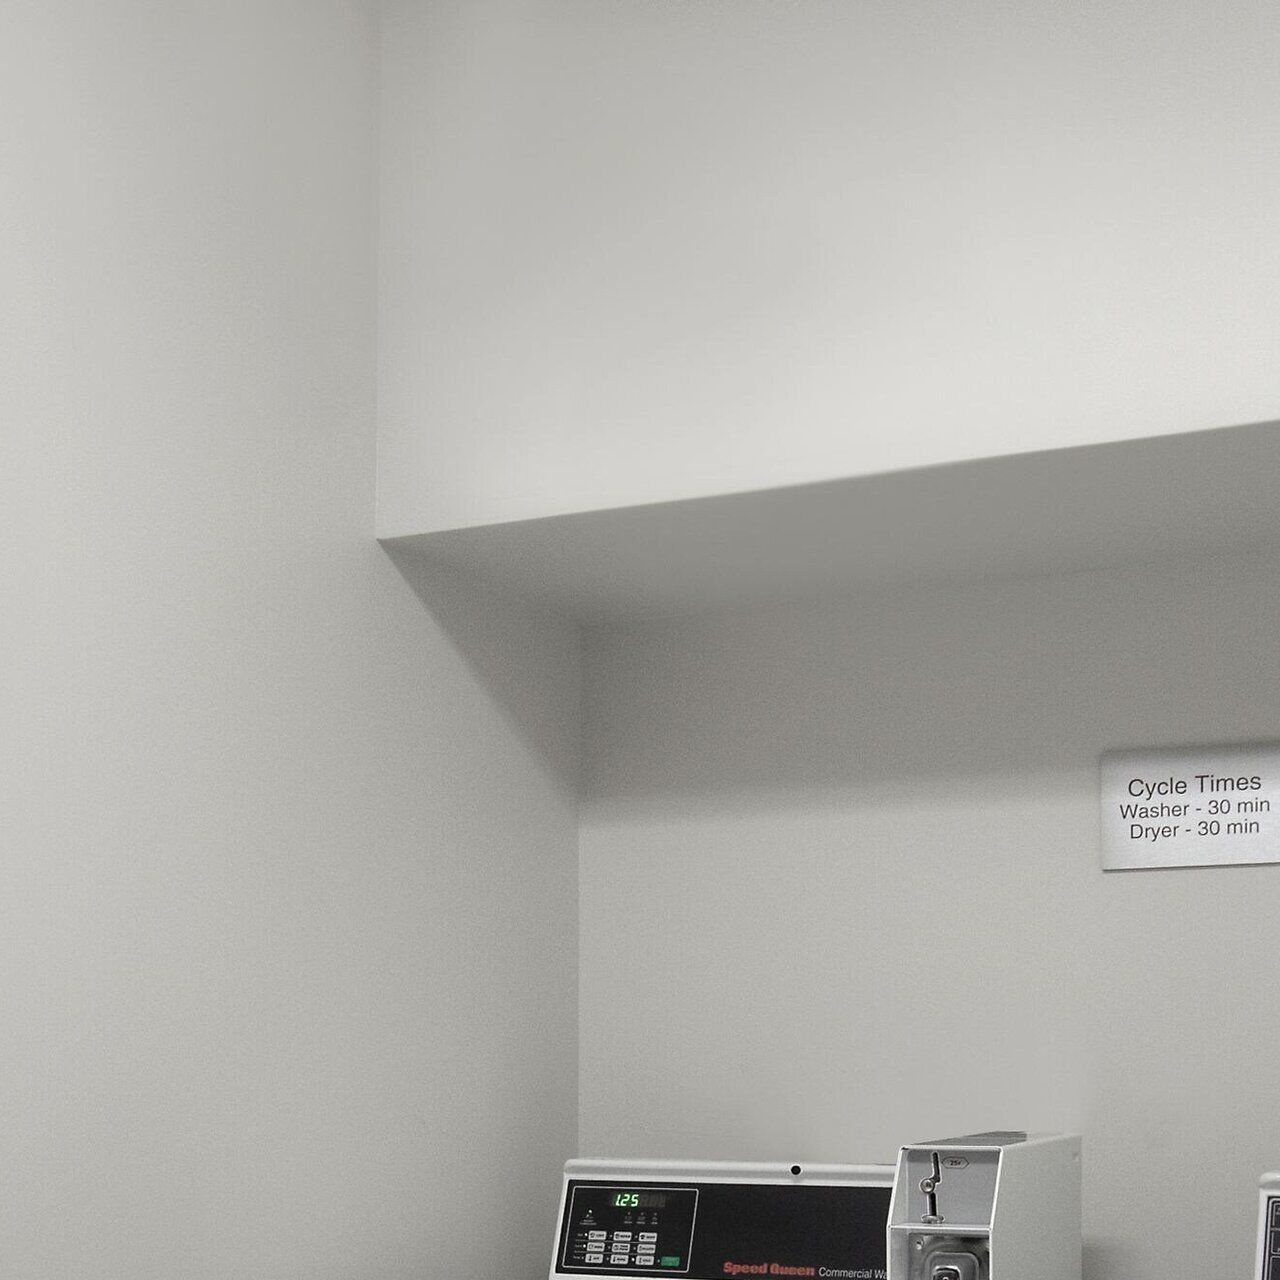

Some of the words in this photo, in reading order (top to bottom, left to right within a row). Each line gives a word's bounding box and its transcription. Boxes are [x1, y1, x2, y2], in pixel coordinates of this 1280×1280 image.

[1128, 777, 1188, 801] Cycle
[1194, 774, 1262, 793] Times
[1120, 803, 1190, 820] Washer
[1208, 800, 1231, 815] 30
[1237, 797, 1270, 813] min
[1130, 824, 1180, 842] Dryer
[1197, 820, 1221, 836] 30
[1226, 818, 1260, 835] min
[723, 1261, 768, 1276] Speed
[770, 1263, 815, 1276] Queen
[818, 1266, 872, 1279] Commercial
[874, 1269, 887, 1280] Wa
